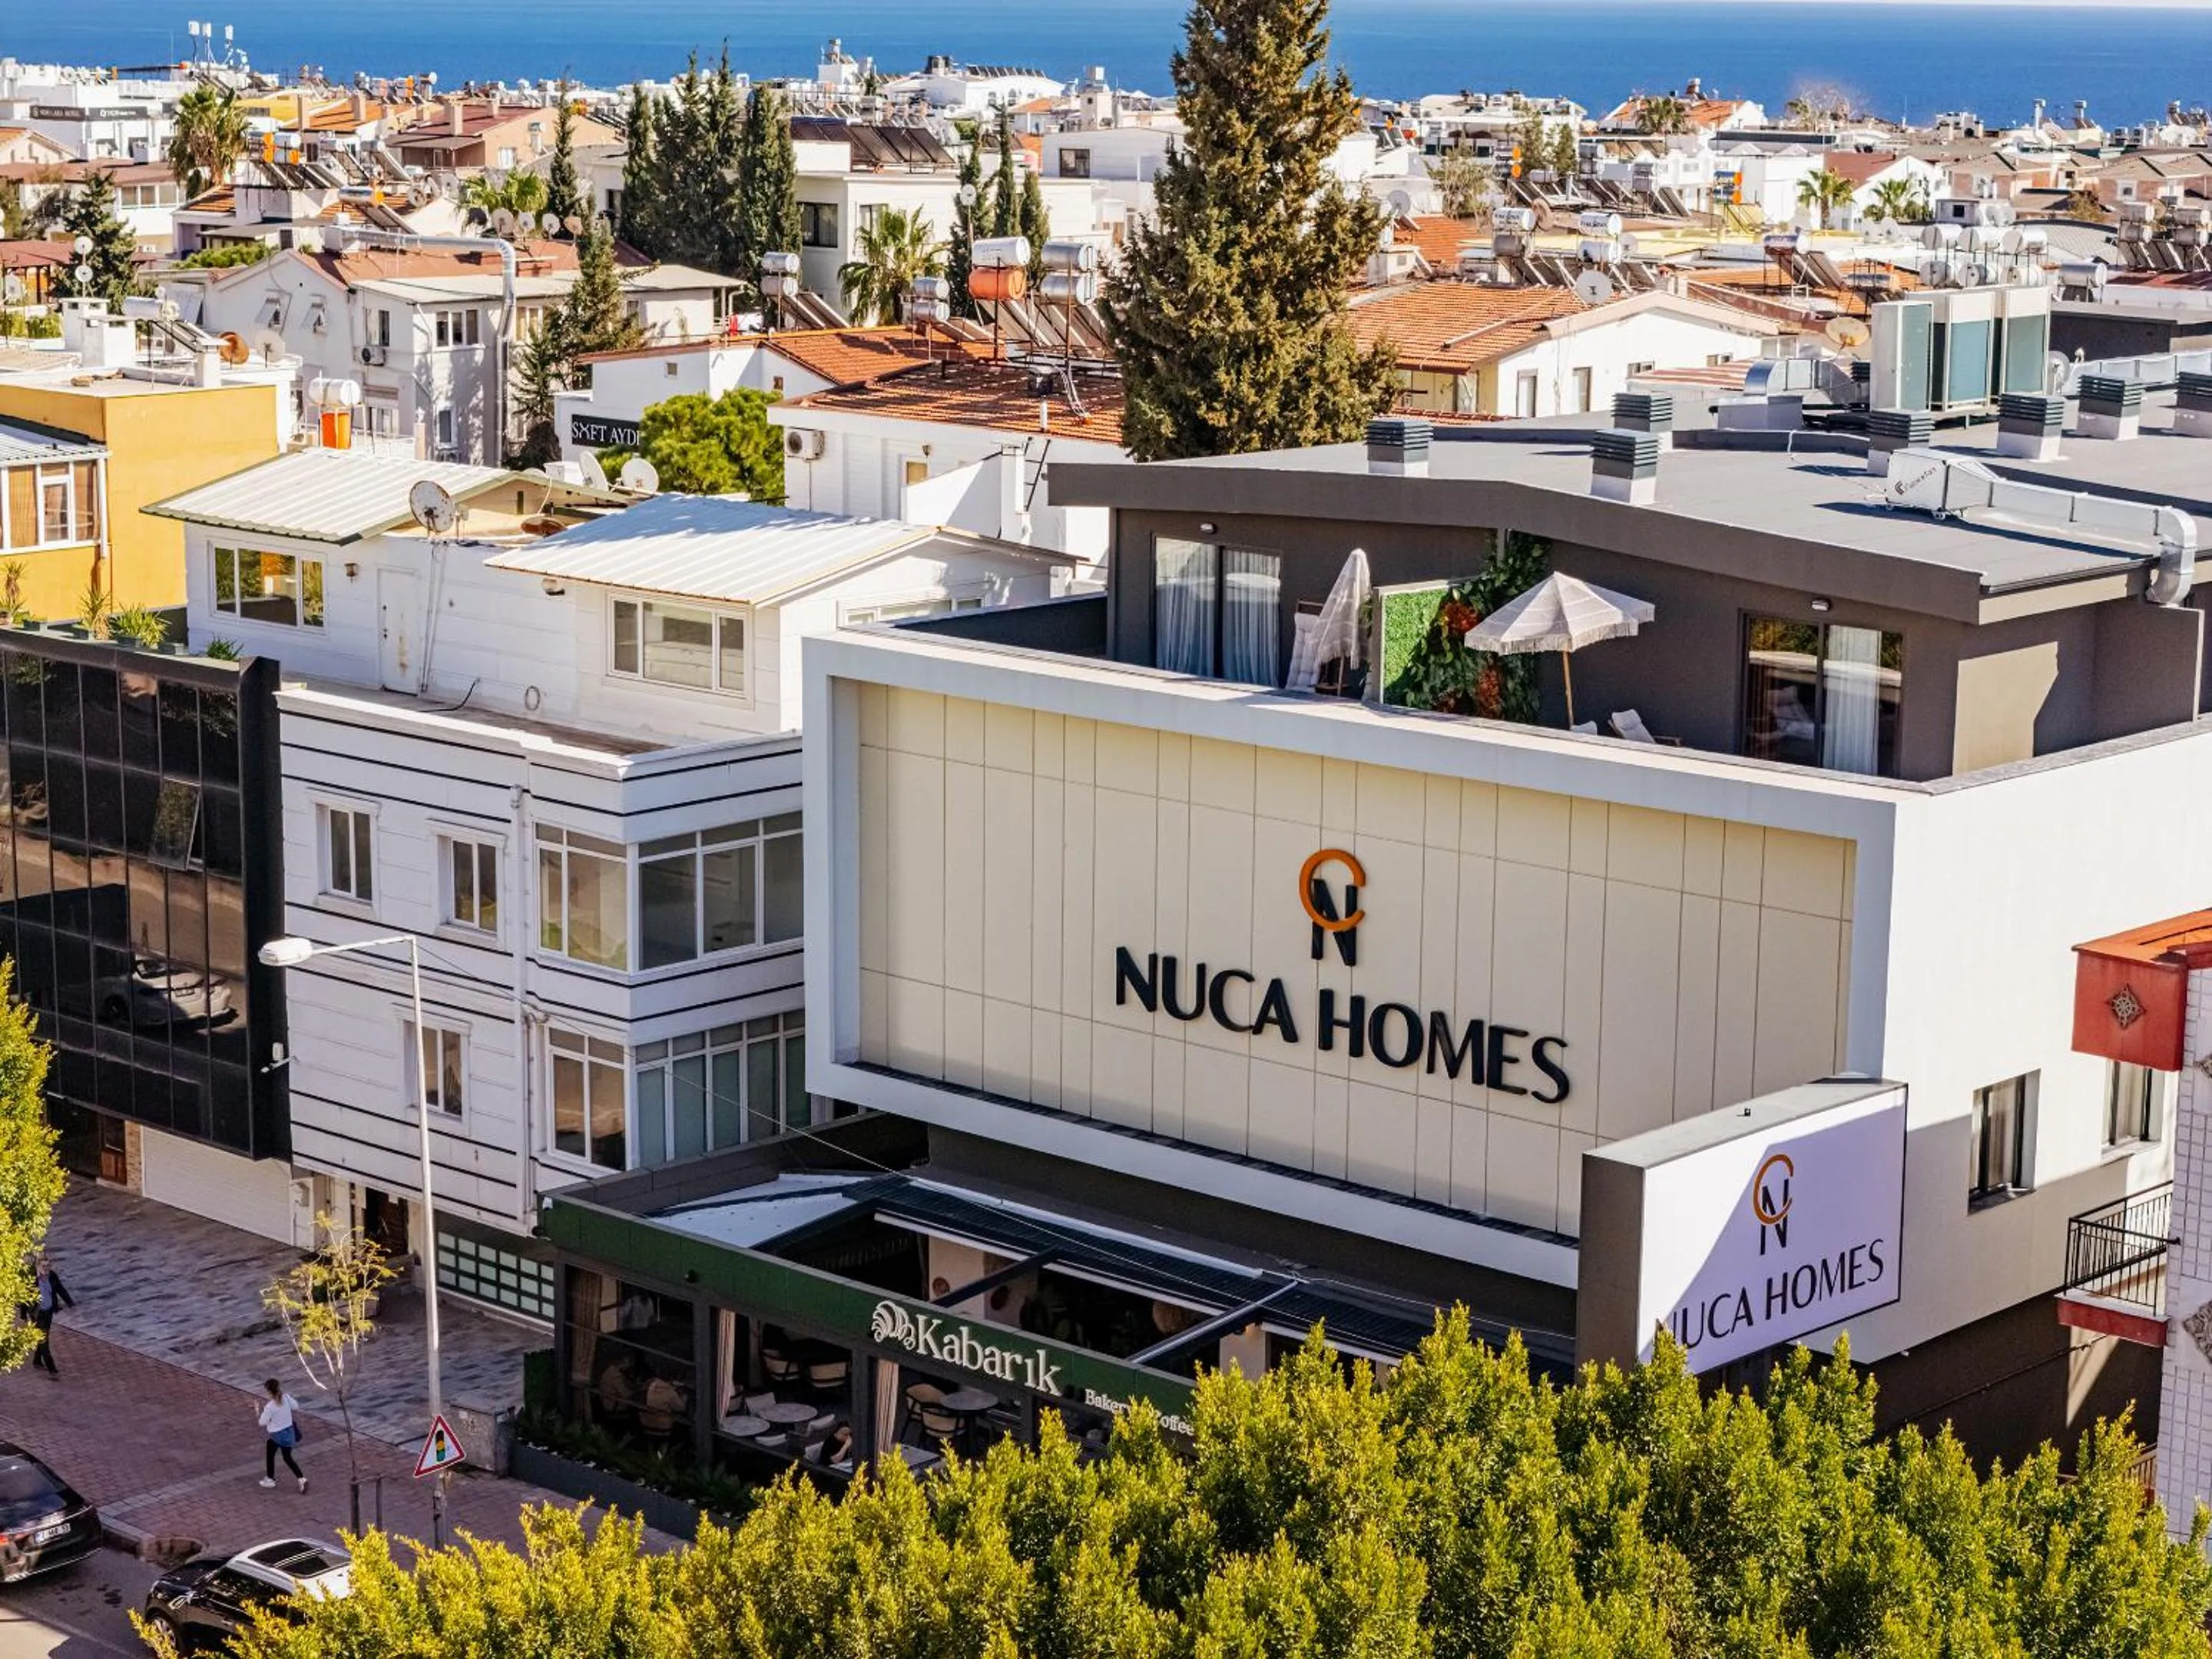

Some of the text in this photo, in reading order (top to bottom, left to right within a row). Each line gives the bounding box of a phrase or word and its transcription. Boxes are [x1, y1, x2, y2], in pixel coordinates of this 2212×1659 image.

[609, 427, 640, 446] AYDI
[1115, 946, 1571, 1104] NUCA HOMES
[1765, 1238, 1885, 1321] HOMES
[1153, 1409, 1195, 1436] offee
